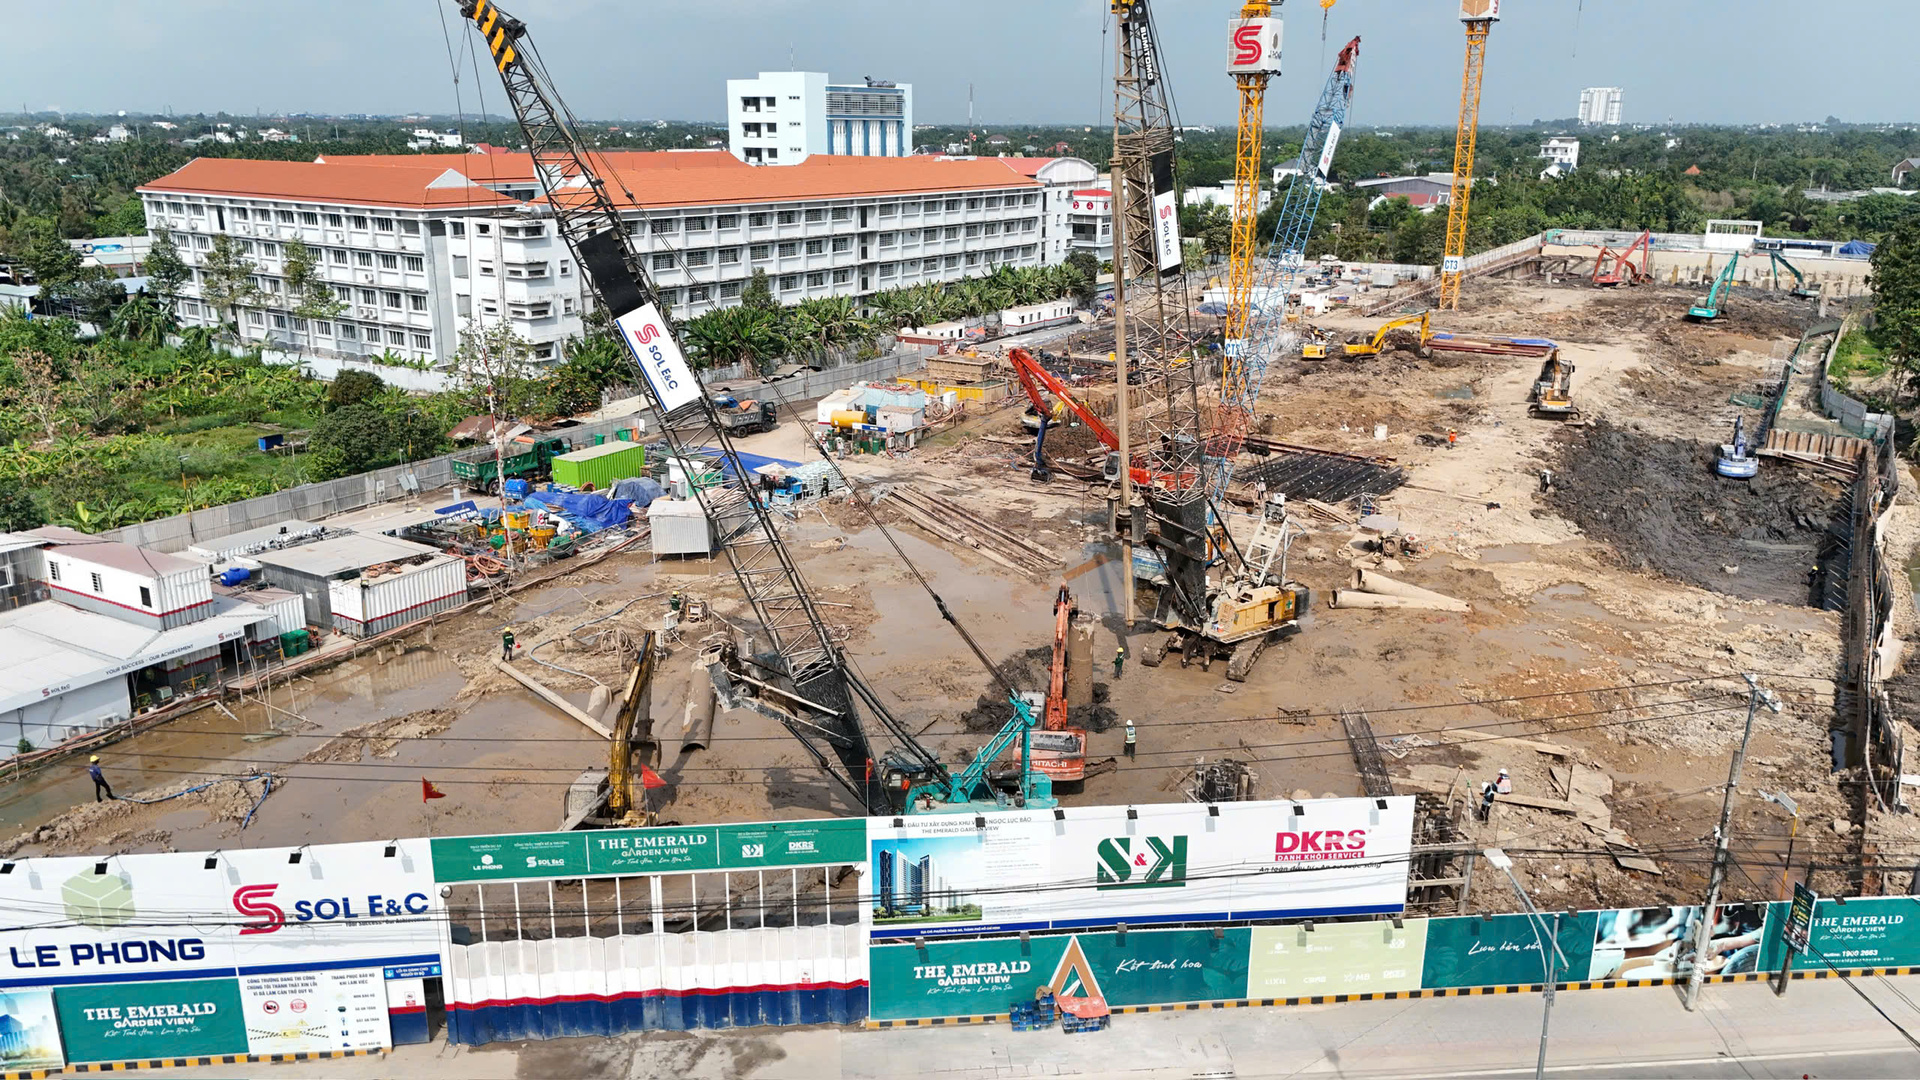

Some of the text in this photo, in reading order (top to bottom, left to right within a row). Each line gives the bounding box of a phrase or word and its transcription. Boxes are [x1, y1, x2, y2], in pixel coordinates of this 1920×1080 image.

[1445, 260, 1458, 270] CT3
[648, 345, 666, 368] SOL
[661, 368, 678, 390] E&C
[106, 666, 120, 675] YOUR
[121, 660, 144, 671] SUCCESS
[160, 644, 194, 658] ACHIEVEMENT
[598, 835, 707, 849] THE EMERALD
[788, 841, 814, 849] DKRS
[1276, 830, 1366, 853] DKRS
[622, 847, 661, 857] GARDEN
[295, 897, 358, 921] SOL
[368, 892, 429, 917] E&C
[1814, 917, 1838, 927] THE
[1842, 915, 1904, 926] EMERALD
[1830, 925, 1863, 933] GARDEN
[10, 938, 205, 968] LE PHONG
[913, 961, 1031, 979] THE EMERALD
[938, 975, 1011, 987] GARDEN VIEW
[83, 1002, 216, 1020] THE EMERALD
[114, 1017, 195, 1028] GARDEN VIEW
